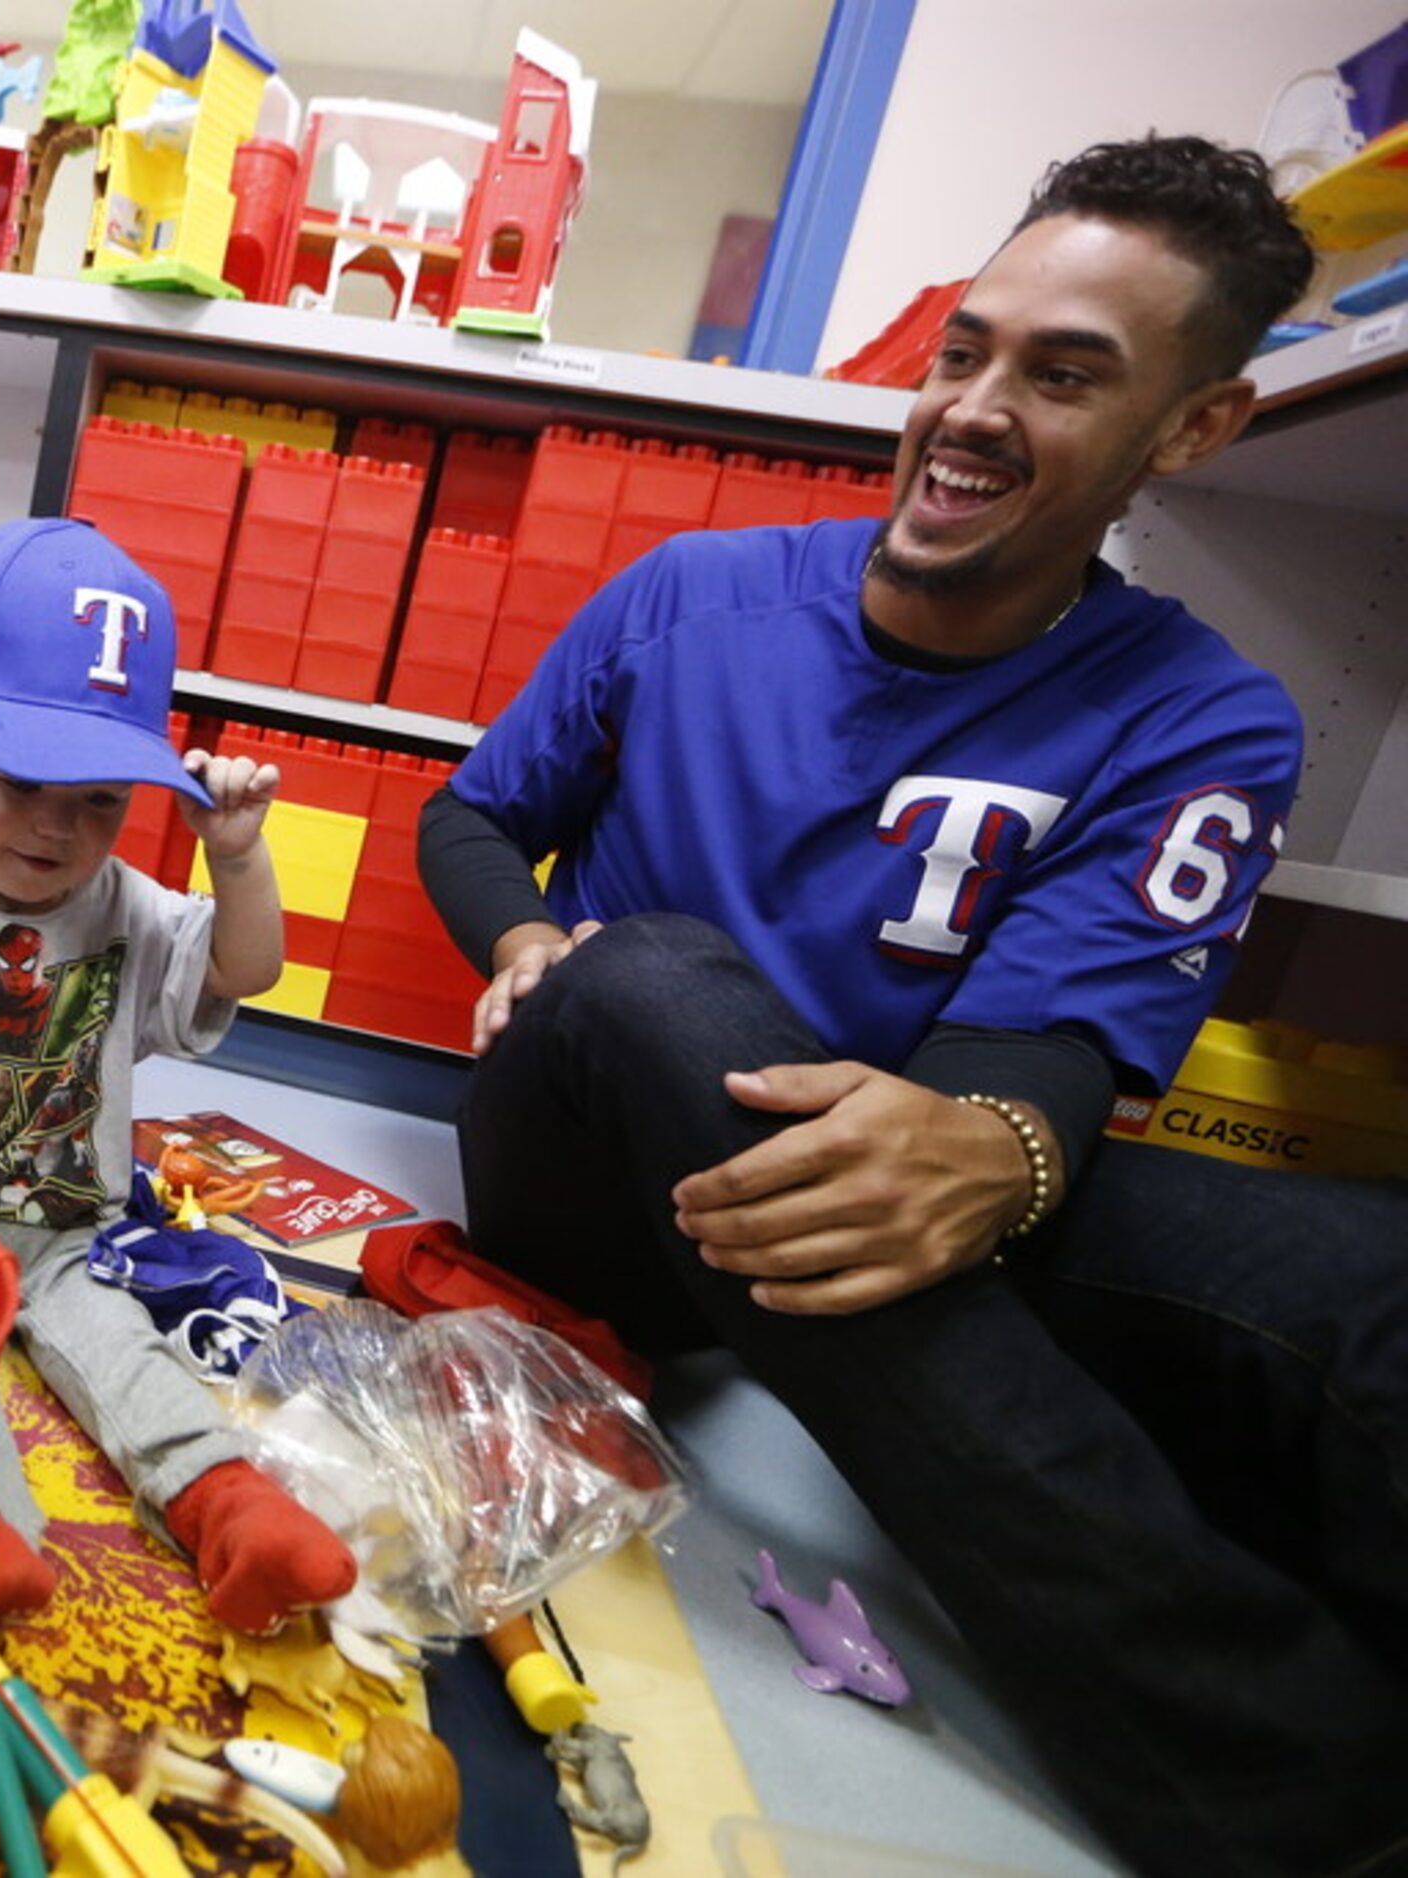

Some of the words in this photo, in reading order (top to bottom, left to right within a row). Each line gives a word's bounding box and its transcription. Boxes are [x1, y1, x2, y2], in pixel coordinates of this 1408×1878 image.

[73, 587, 148, 693] T
[876, 774, 1069, 966] T
[1138, 786, 1284, 942] 6
[1162, 1107, 1312, 1161] CLASSIC
